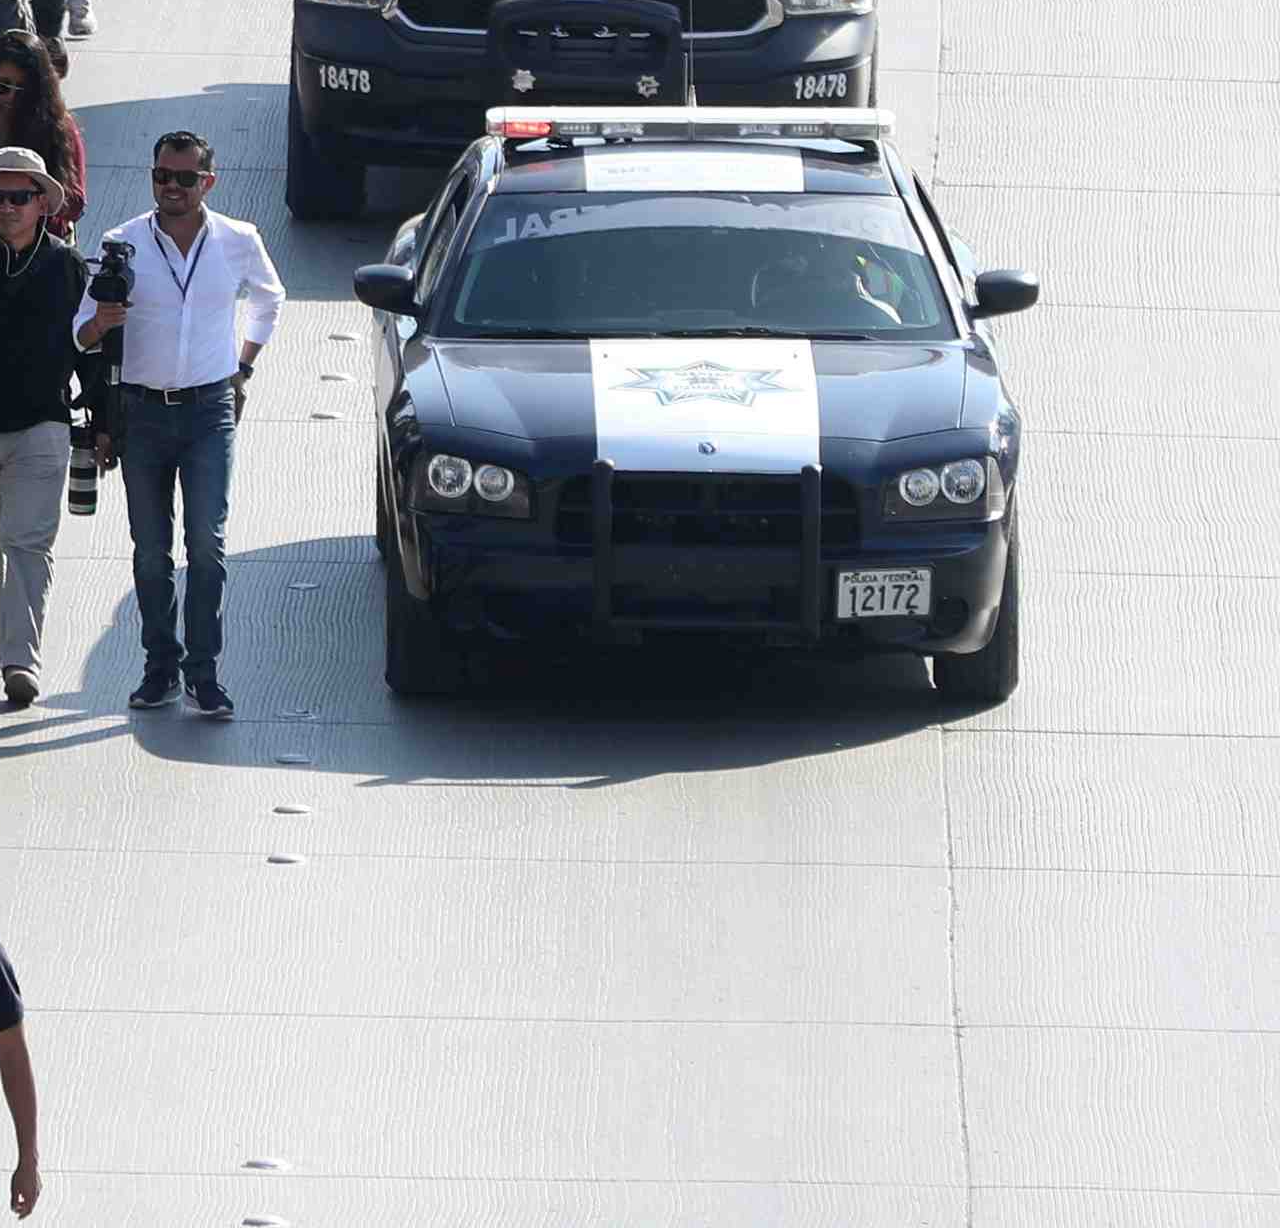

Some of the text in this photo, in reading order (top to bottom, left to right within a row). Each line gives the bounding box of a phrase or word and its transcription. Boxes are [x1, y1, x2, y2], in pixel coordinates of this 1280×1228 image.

[317, 62, 848, 100] 18478 18478
[849, 584, 920, 612] 12172
